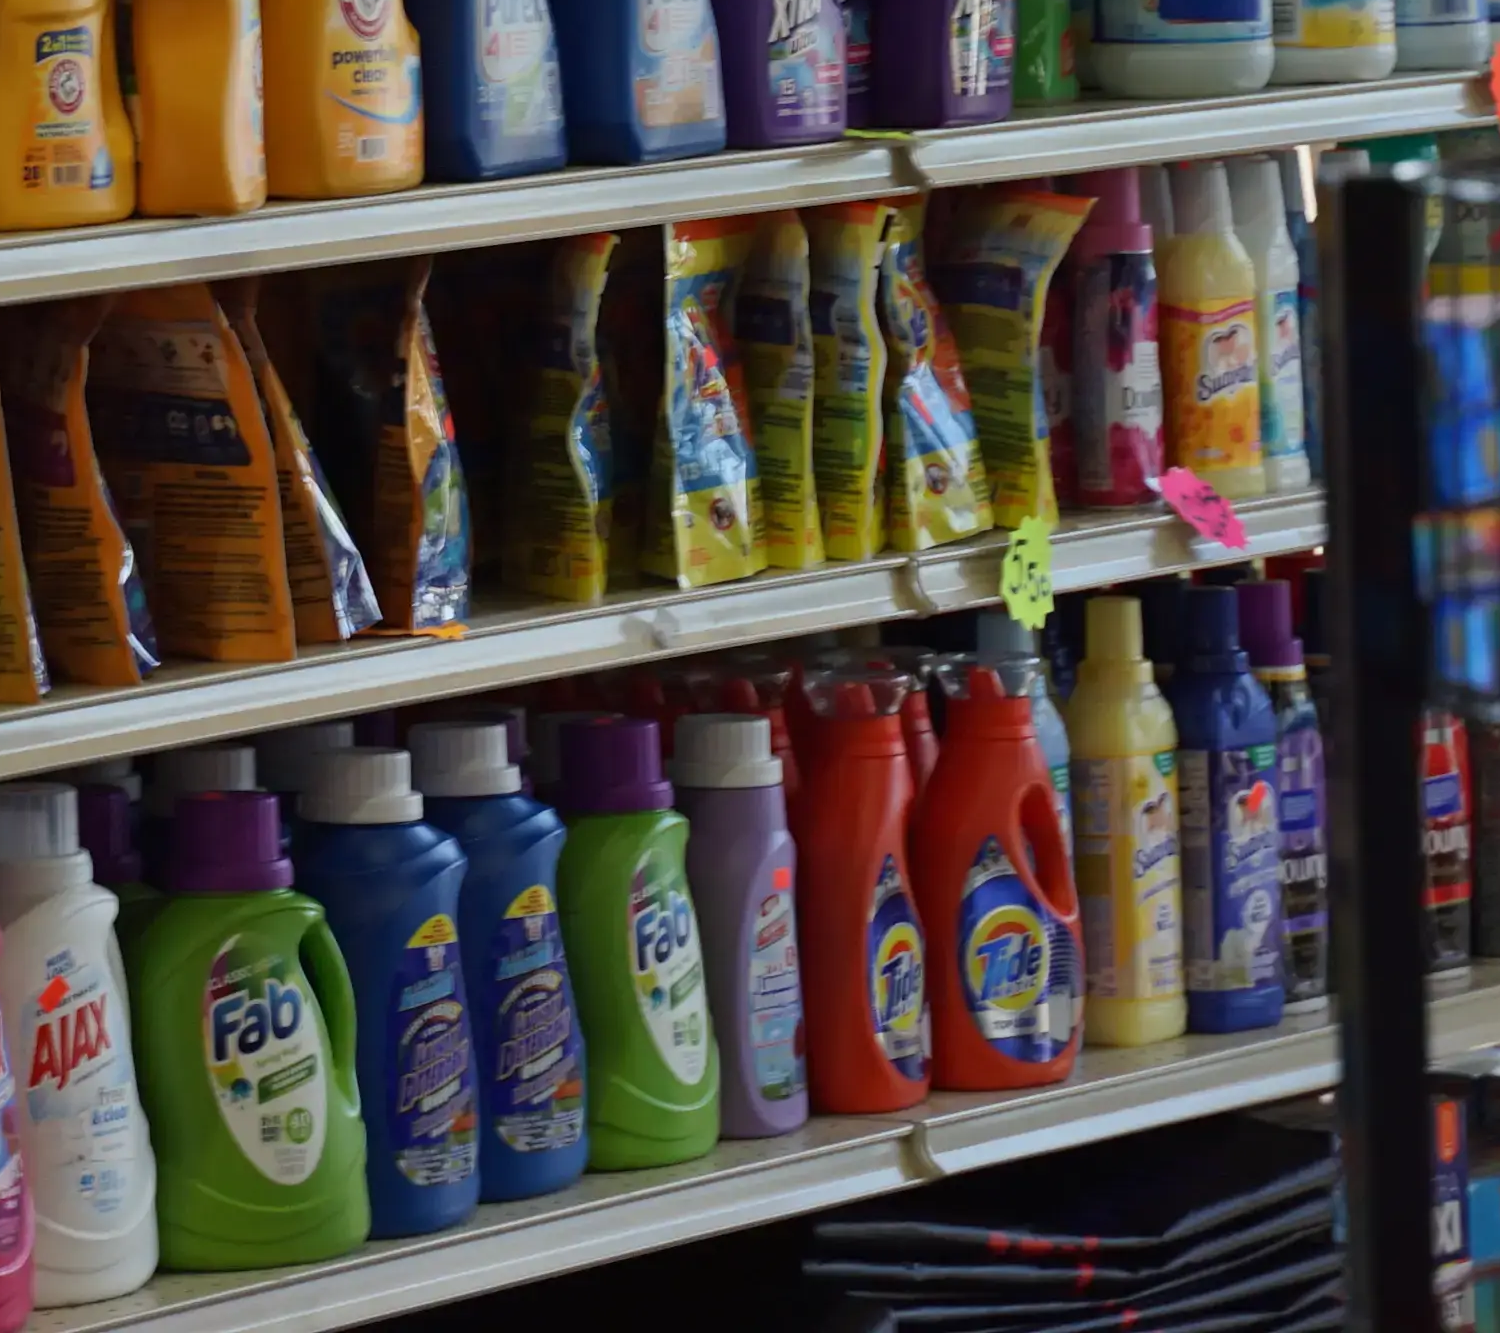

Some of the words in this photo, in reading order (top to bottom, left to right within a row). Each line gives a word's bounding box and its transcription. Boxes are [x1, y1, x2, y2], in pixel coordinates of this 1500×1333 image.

[332, 47, 400, 69] powerfu
[1134, 835, 1180, 879] Suavi
[1280, 855, 1328, 889] owny
[1423, 825, 1470, 859] owny
[636, 891, 691, 971] Fab
[881, 952, 921, 1031] Tide
[976, 932, 1044, 1007] Tide
[27, 994, 112, 1091] AJAX
[211, 979, 302, 1065] Fab
